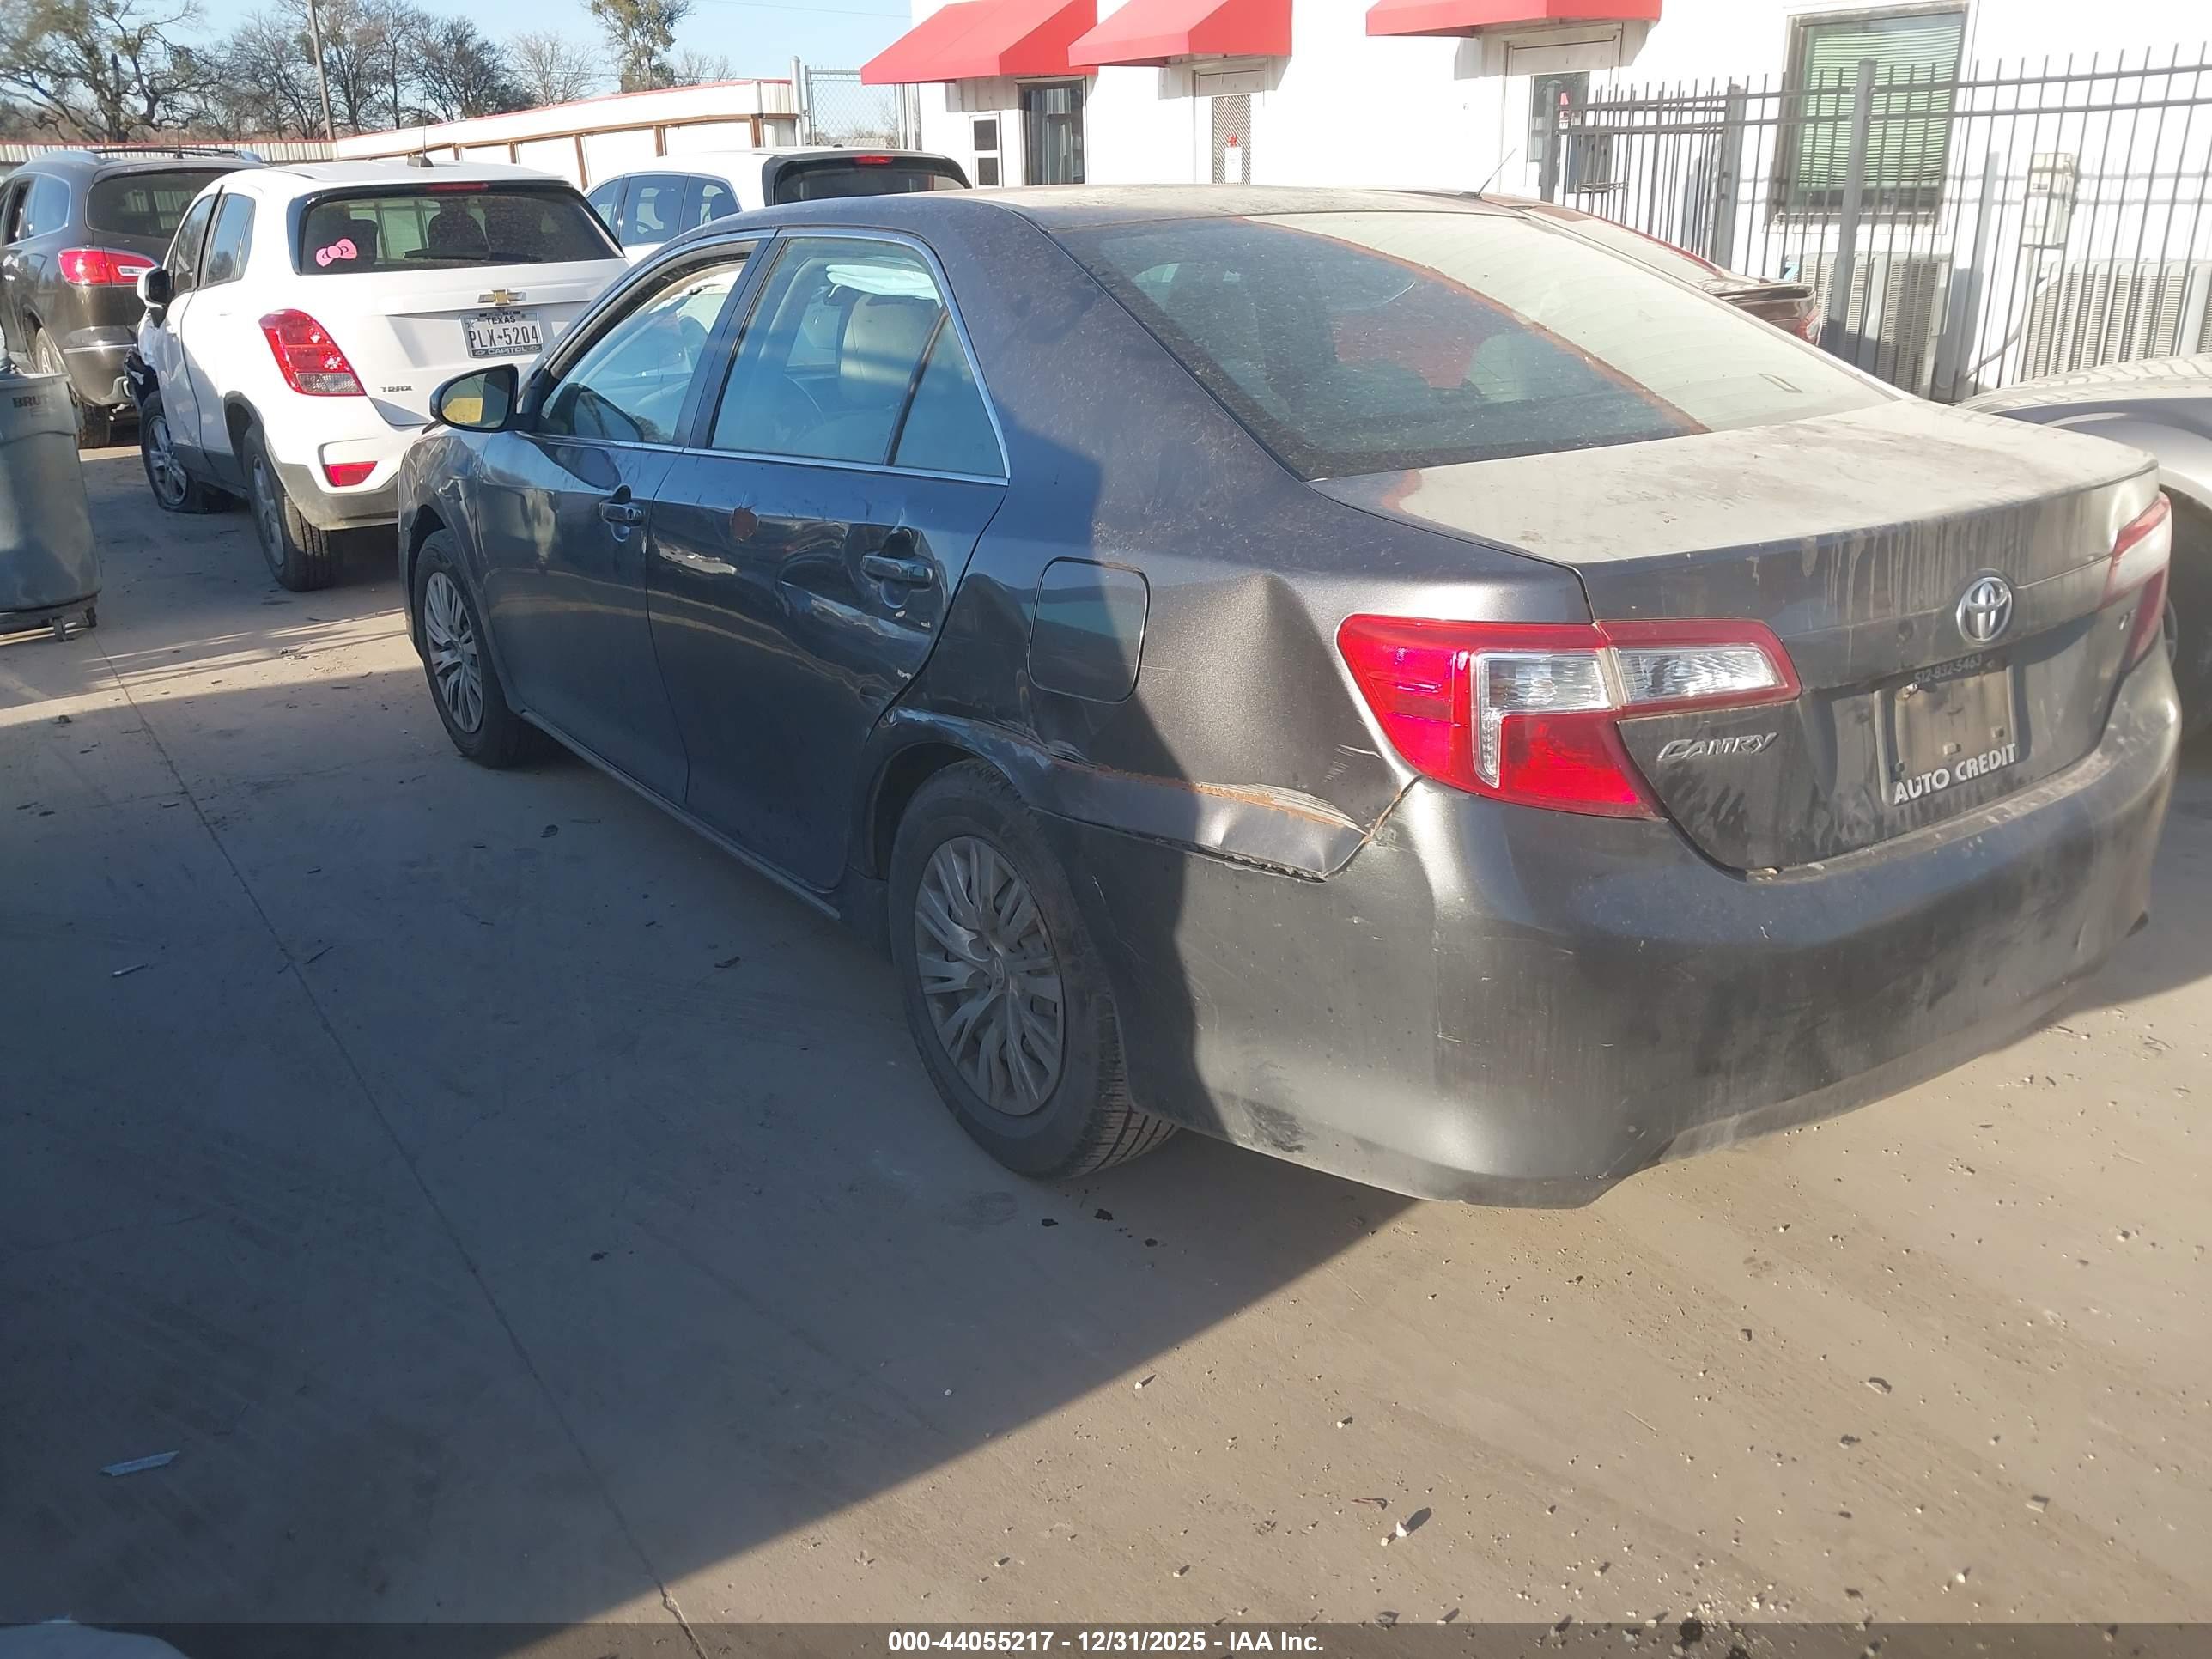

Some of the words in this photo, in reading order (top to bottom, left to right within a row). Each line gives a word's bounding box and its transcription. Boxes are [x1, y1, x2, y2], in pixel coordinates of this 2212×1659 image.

[486, 315, 516, 325] TEXAS
[488, 346, 526, 355] CAPITOL
[1656, 732, 1779, 761] CAMRY
[1894, 768, 1950, 805] AUTO
[1955, 743, 2016, 780] CREDIT
